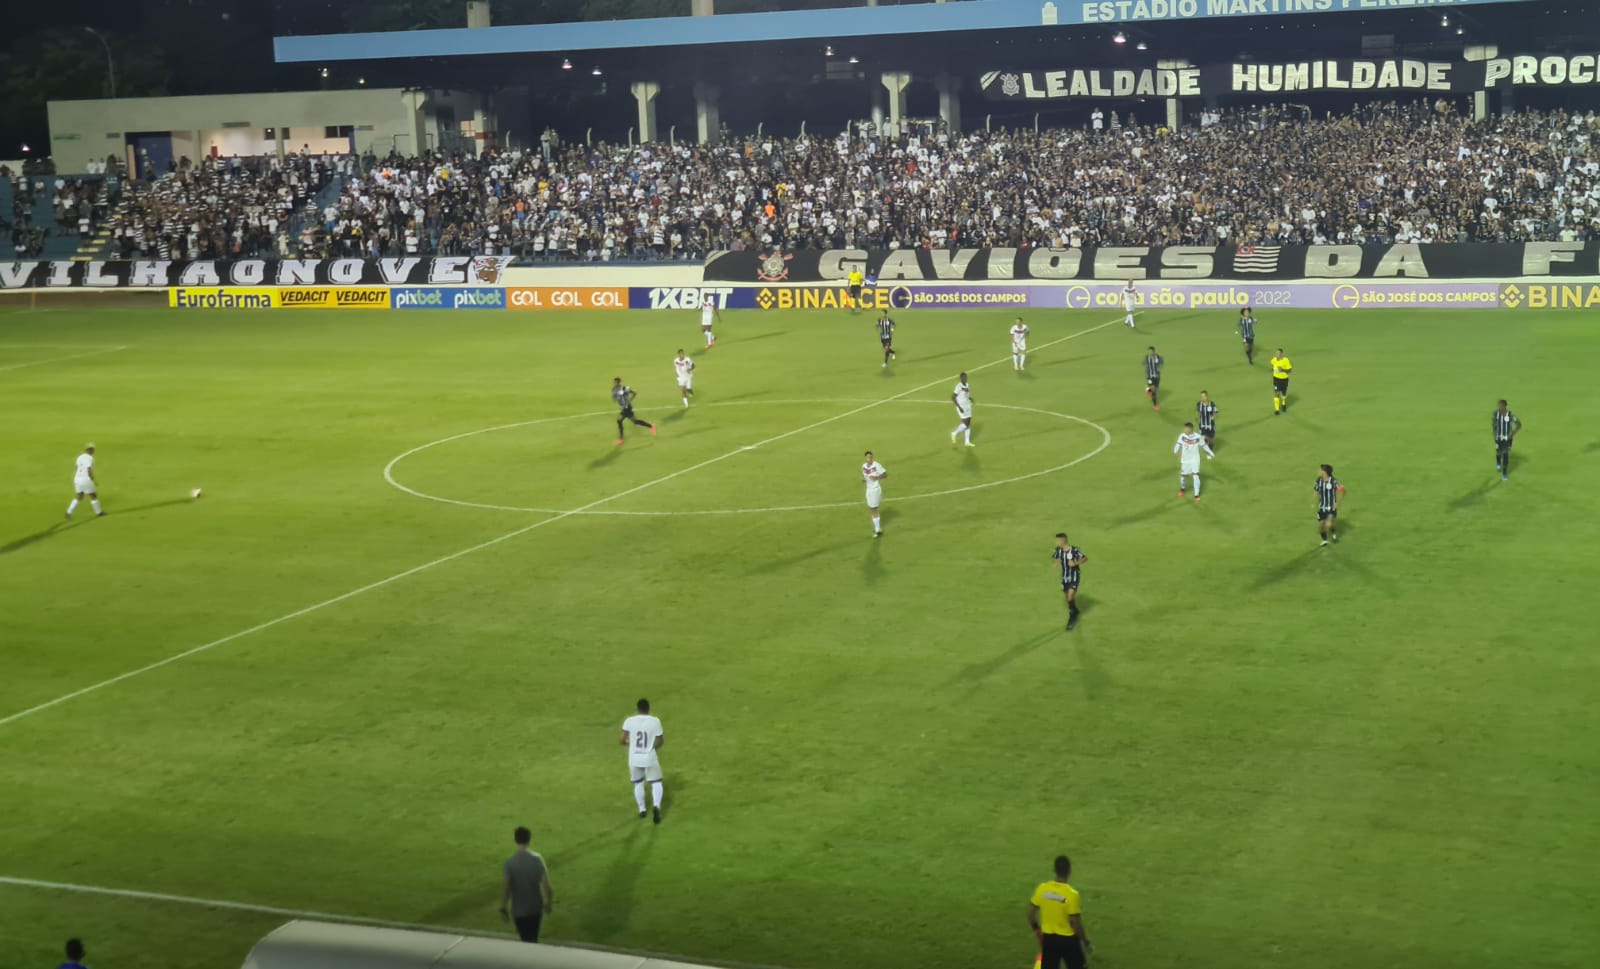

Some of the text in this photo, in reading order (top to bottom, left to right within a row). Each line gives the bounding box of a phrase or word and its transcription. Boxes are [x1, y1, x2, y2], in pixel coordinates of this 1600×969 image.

[1022, 55, 1600, 98] LEALDADE HUMILDADE PROC
[1305, 243, 1430, 278] DA
[1523, 241, 1600, 276] F
[177, 289, 272, 308] Eurofarma
[280, 290, 387, 302] VEDACIT VEDACIT
[396, 287, 502, 308] pixbet pixbet
[511, 290, 623, 306] GOL GOL GOL
[914, 291, 1027, 303] SÃO JOSÉ DOS CAMPOS
[1096, 287, 1291, 309] coa são paulo 2022
[1362, 291, 1496, 303] SÃO JOSÉ DOS CAMPOS
[636, 731, 648, 748] 21
